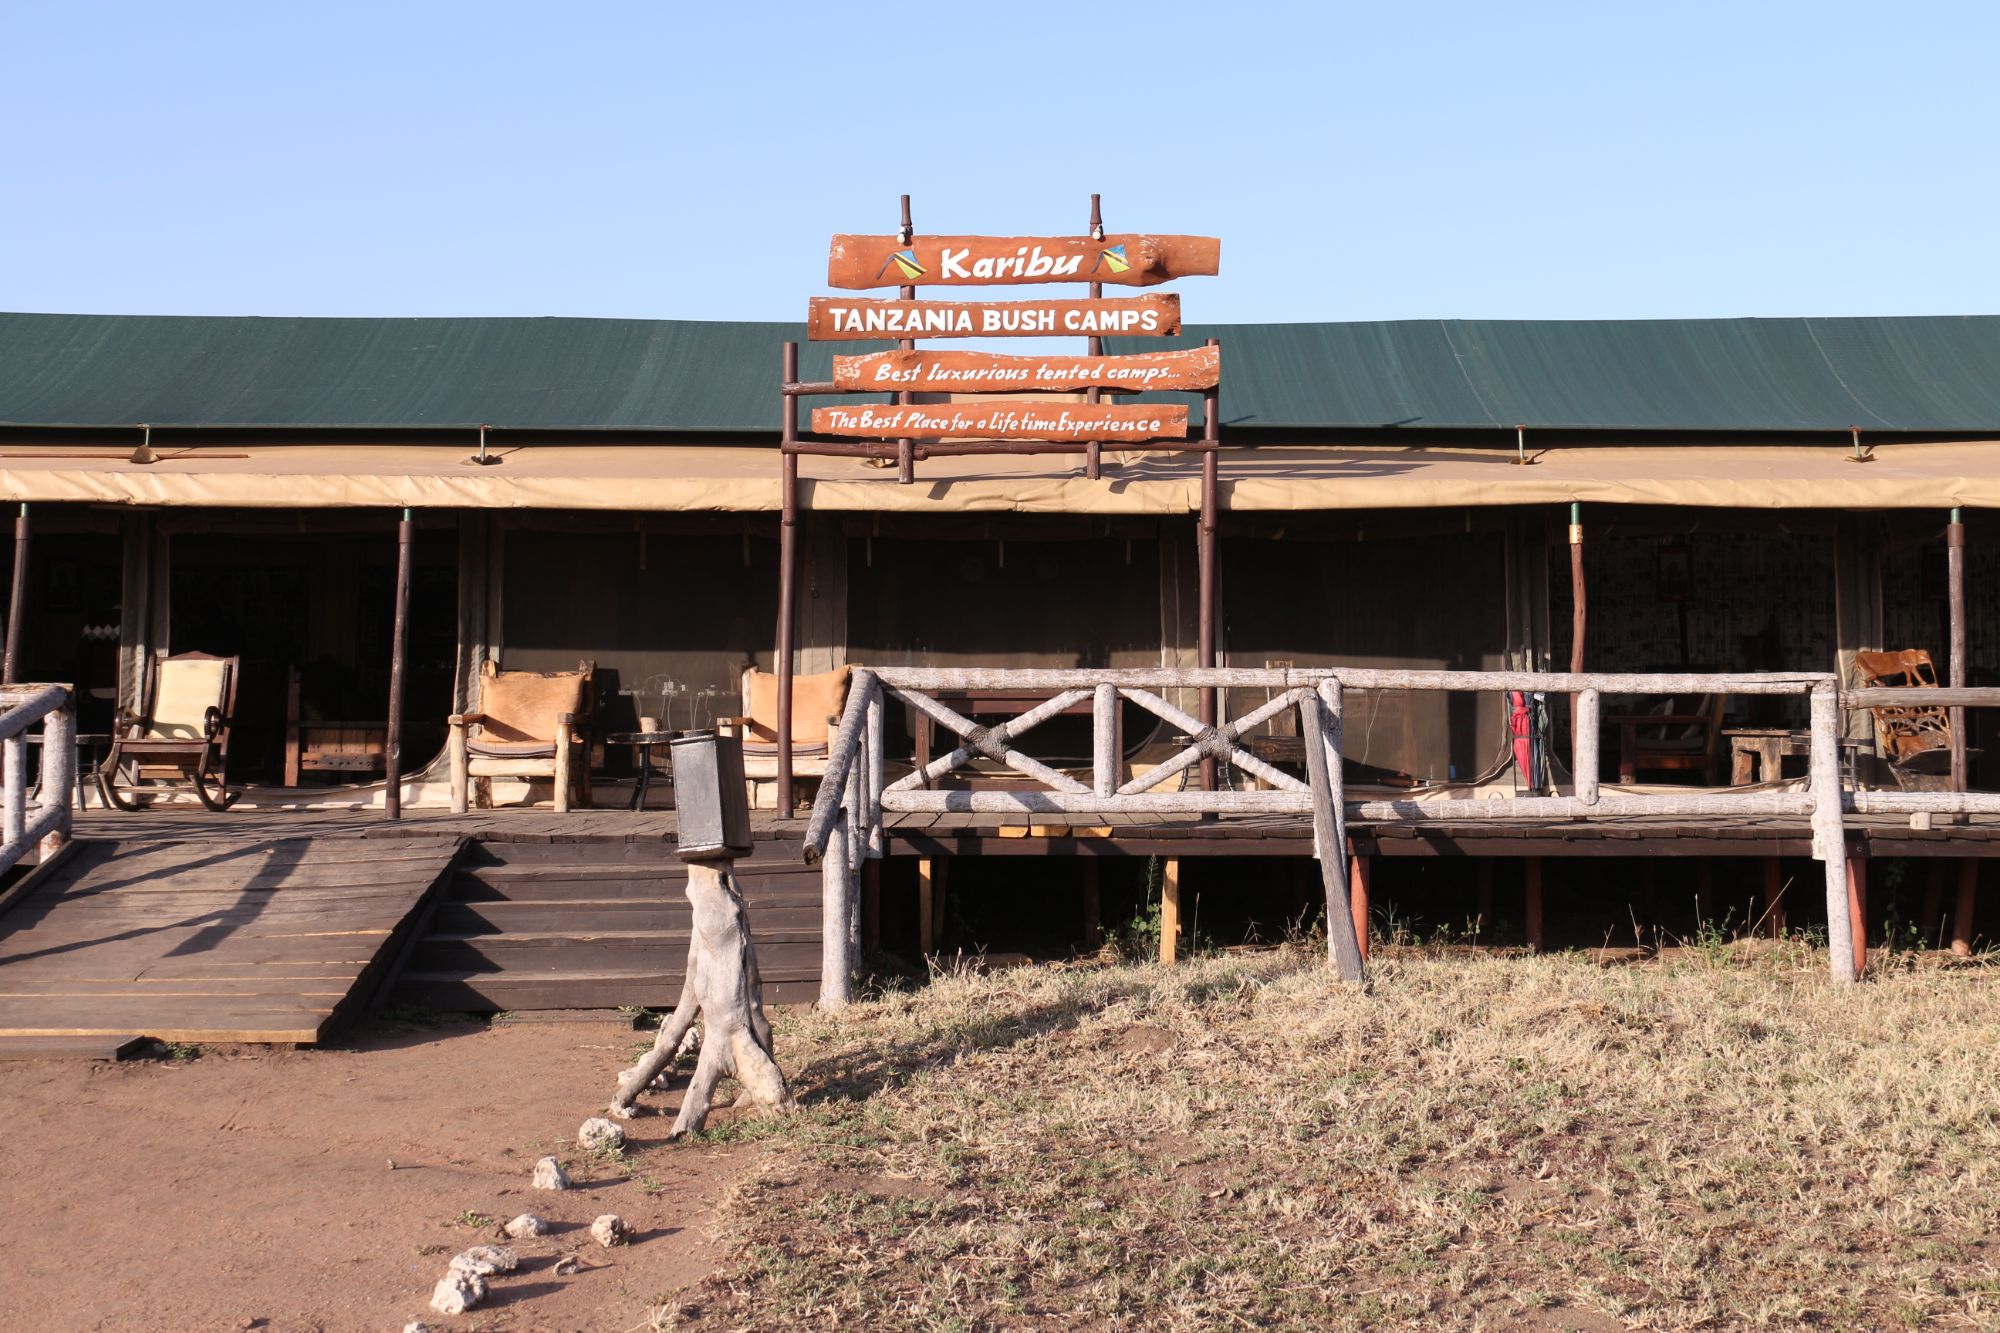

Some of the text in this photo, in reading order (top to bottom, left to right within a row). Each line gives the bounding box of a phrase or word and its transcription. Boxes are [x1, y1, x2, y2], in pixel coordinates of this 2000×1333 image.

[941, 246, 1084, 279] Karibu
[829, 308, 1159, 332] TANZANIA BUSH CAMPS
[874, 363, 1180, 384] Best luxurious tented camps...
[829, 412, 856, 429] The
[860, 411, 903, 429] Best
[904, 412, 949, 429] Place
[950, 412, 973, 431] for
[977, 419, 987, 429] a
[1058, 412, 1161, 436] Experience
